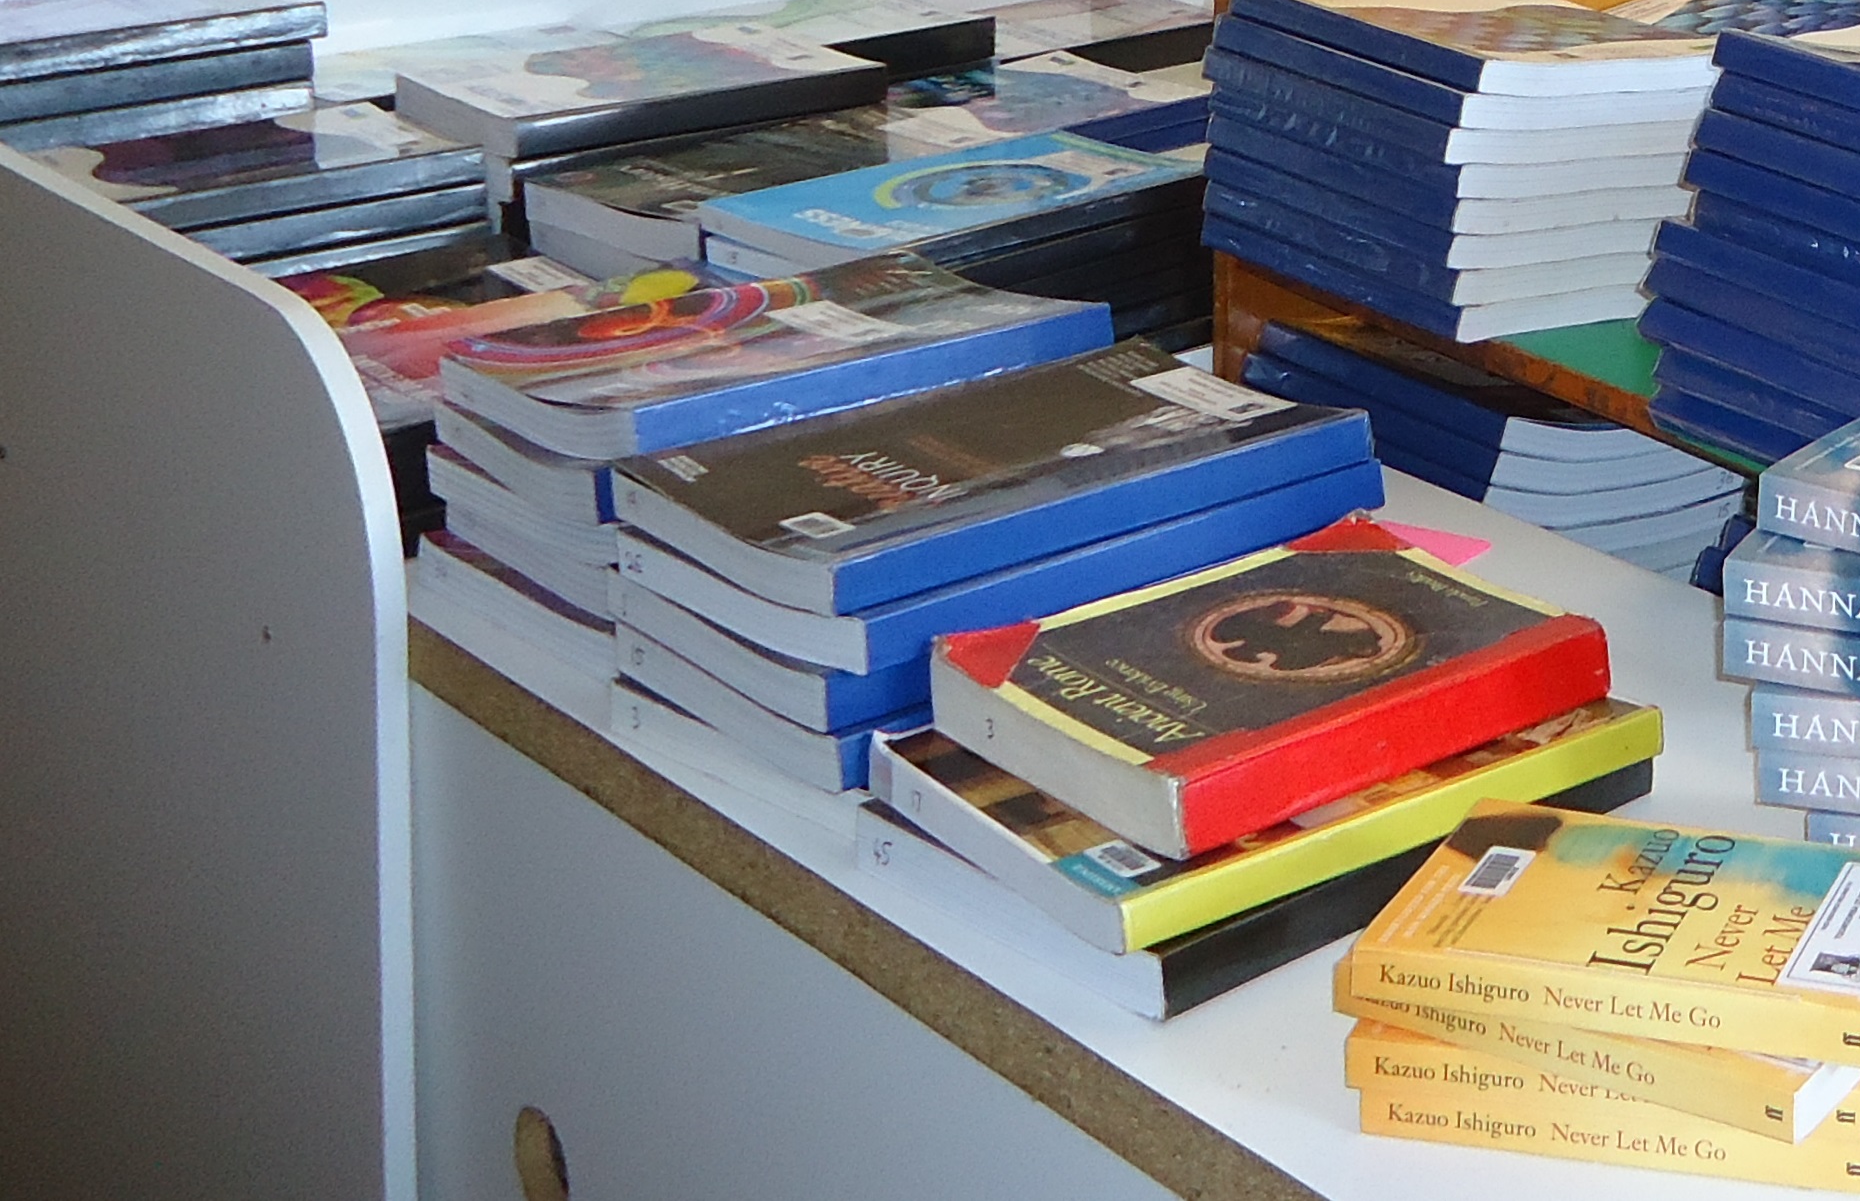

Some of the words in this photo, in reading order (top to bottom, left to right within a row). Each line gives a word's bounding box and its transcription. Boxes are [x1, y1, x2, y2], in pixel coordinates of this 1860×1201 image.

[1026, 654, 1107, 703] Rome
[985, 718, 996, 740] 3
[1092, 692, 1205, 744] Ancient
[1596, 828, 1680, 895] Kazuo
[1585, 834, 1736, 976] Ishiguro
[1762, 904, 1817, 943] Me
[1684, 903, 1760, 971] Never
[1735, 942, 1795, 987] Let
[1378, 963, 1441, 990] Kazuo
[1448, 972, 1530, 1004] Ishiguro
[1542, 985, 1603, 1013] Never
[1609, 995, 1643, 1019] Let
[1649, 1001, 1682, 1024] Me
[1688, 1006, 1721, 1030] Go
[1415, 1004, 1487, 1036] Ishiguro
[1499, 1021, 1550, 1055] Never
[1556, 1040, 1588, 1067] Let
[1591, 1050, 1623, 1075] Me
[1626, 1061, 1656, 1086] Go
[1374, 1055, 1436, 1082] Kazuo
[1442, 1063, 1525, 1091] Ishiguro
[1538, 1072, 1599, 1099] Never
[1387, 1103, 1450, 1129] Kazuo
[1454, 1111, 1537, 1139] Ishiguro
[1550, 1121, 1610, 1148] Never
[1616, 1128, 1650, 1152] Let
[1655, 1135, 1688, 1158] Me
[1694, 1138, 1727, 1163] Go
